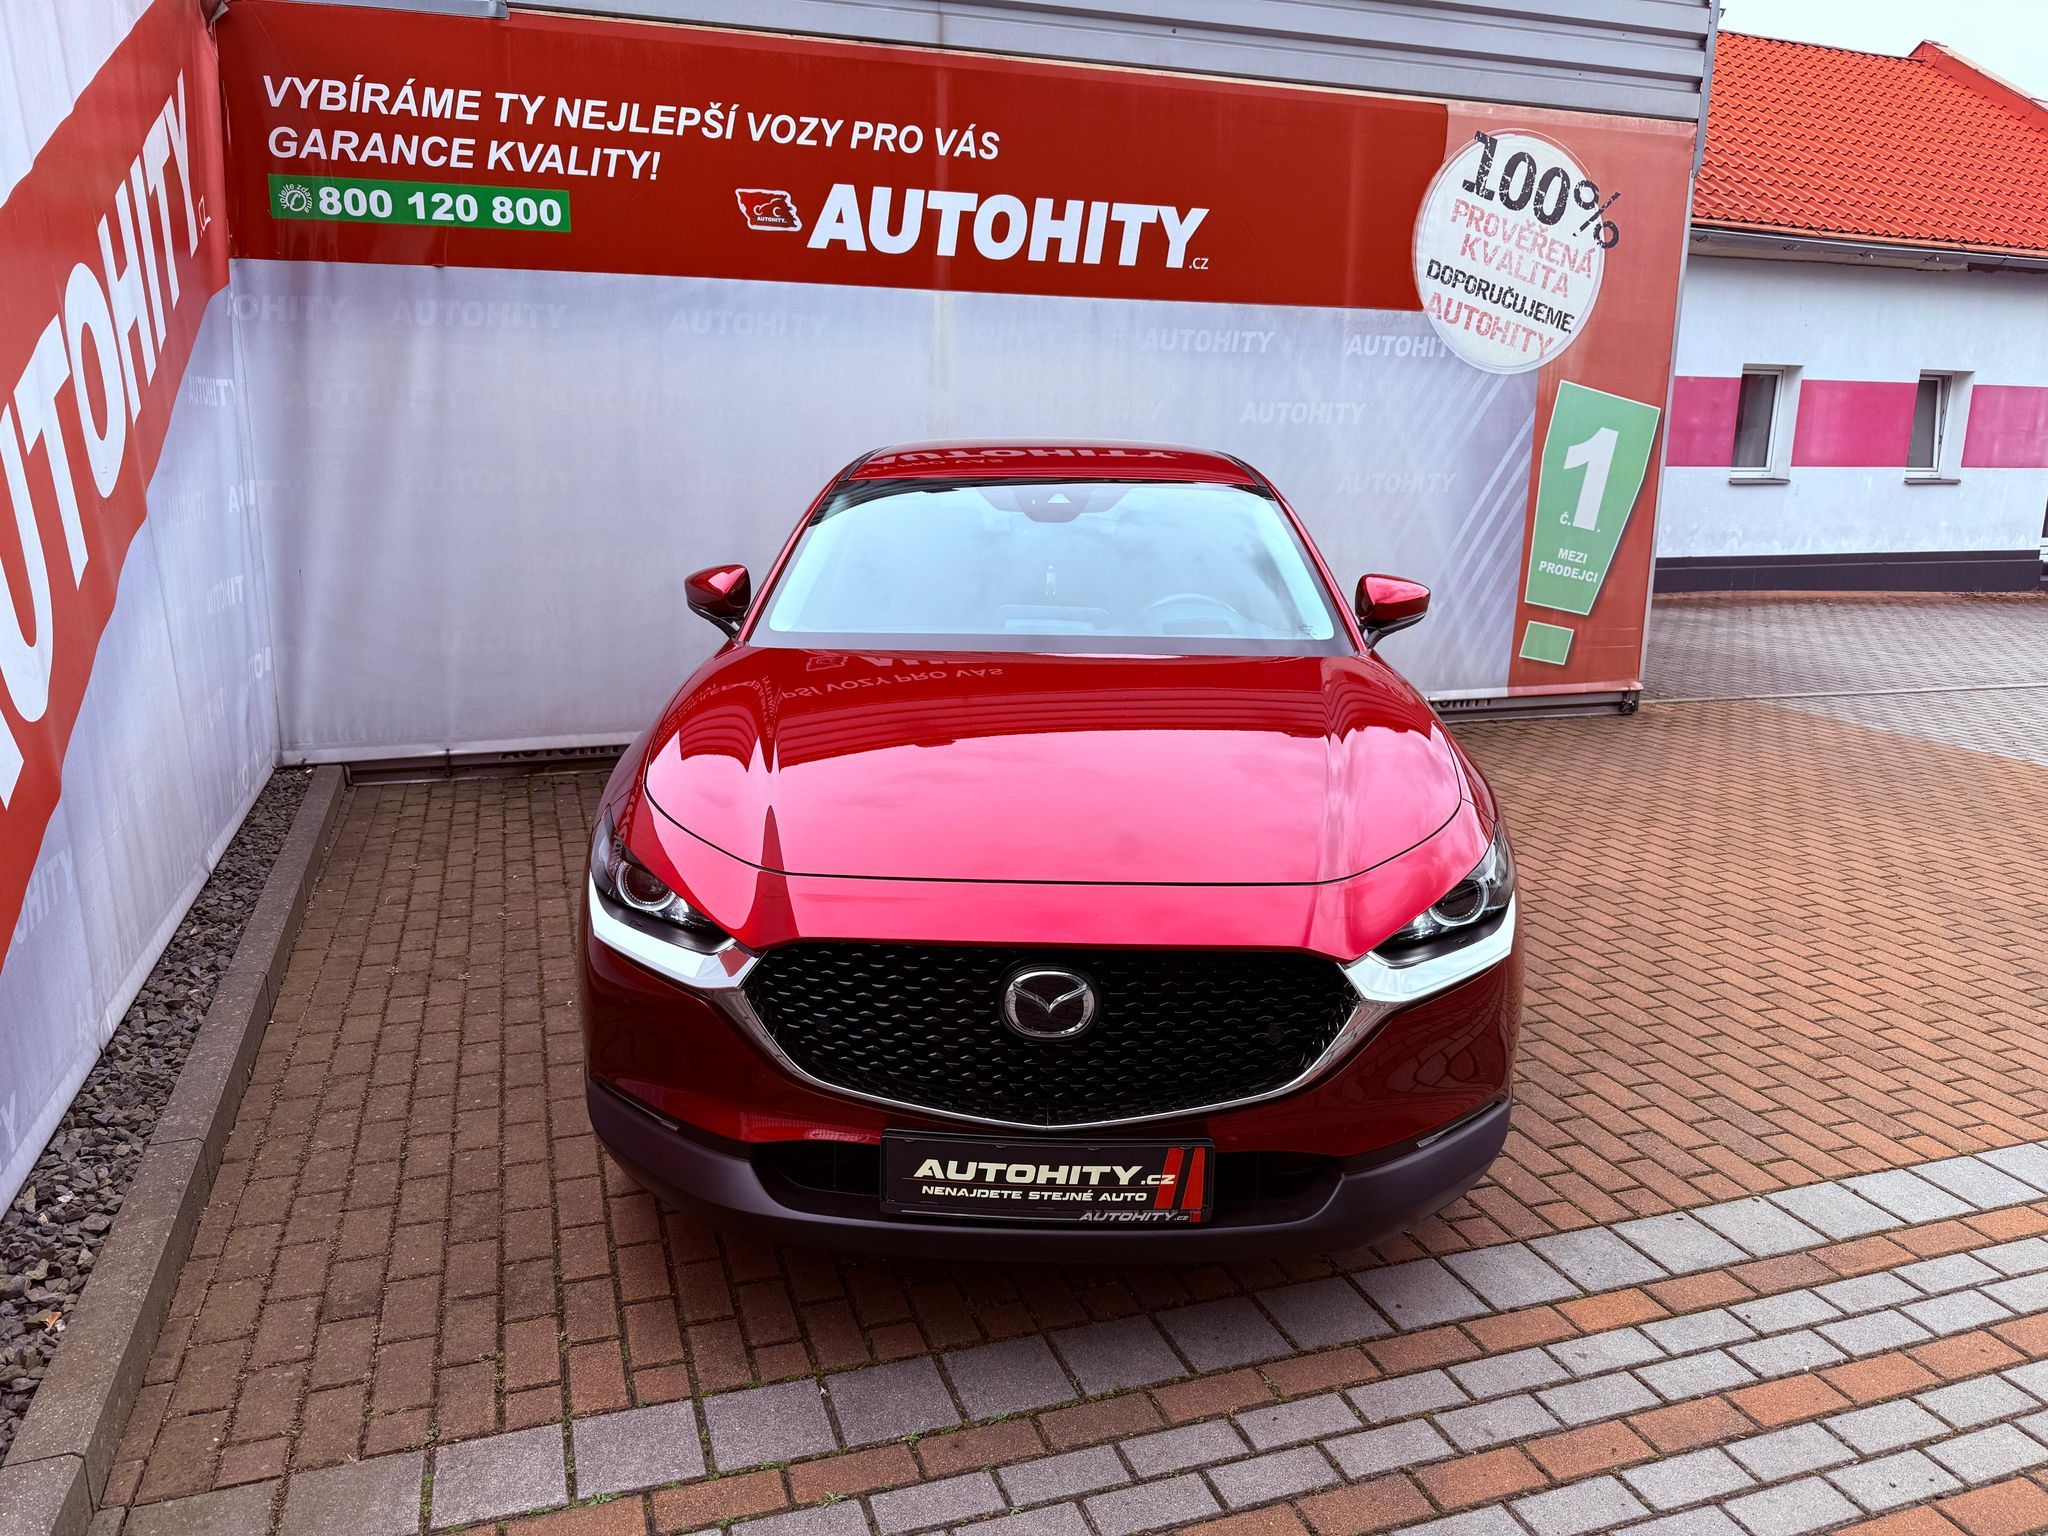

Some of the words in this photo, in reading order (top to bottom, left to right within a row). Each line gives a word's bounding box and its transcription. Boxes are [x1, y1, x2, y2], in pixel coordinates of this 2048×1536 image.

[263, 74, 482, 122] VYBÍRÁME
[495, 92, 547, 125] TY
[554, 97, 738, 142] NEJLEPŠÍ
[748, 113, 844, 147] VOZY
[851, 121, 924, 155] PRO
[935, 124, 1001, 162] VÁS
[268, 126, 475, 170] GARANCE
[487, 141, 661, 182] KVALITY!
[278, 183, 295, 209] volejte
[296, 184, 313, 214] zdarma
[1462, 130, 1621, 250] 100%
[318, 186, 394, 218] 800
[408, 191, 479, 222] 120
[492, 195, 562, 228] 800
[1450, 198, 1597, 280] PROVĚŘENÁ
[1459, 232, 1569, 299] KVALITA
[1425, 258, 1575, 335] DOPORUČUJEME
[390, 299, 568, 330] AUTOHITY
[668, 308, 827, 338] AUTOHITY
[1425, 291, 1556, 359] AUTOHITY
[1143, 328, 1275, 354] AUTOHITY
[1239, 402, 1367, 424] AUTOHITY
[1337, 472, 1458, 494] AUTOHITY
[1538, 560, 1599, 584] PRODEJCI
[1557, 547, 1588, 566] MEZI
[921, 1184, 1023, 1201] NENAJDETE
[1028, 1189, 1093, 1202] STEJNÉ
[1098, 1192, 1149, 1203] AUTO
